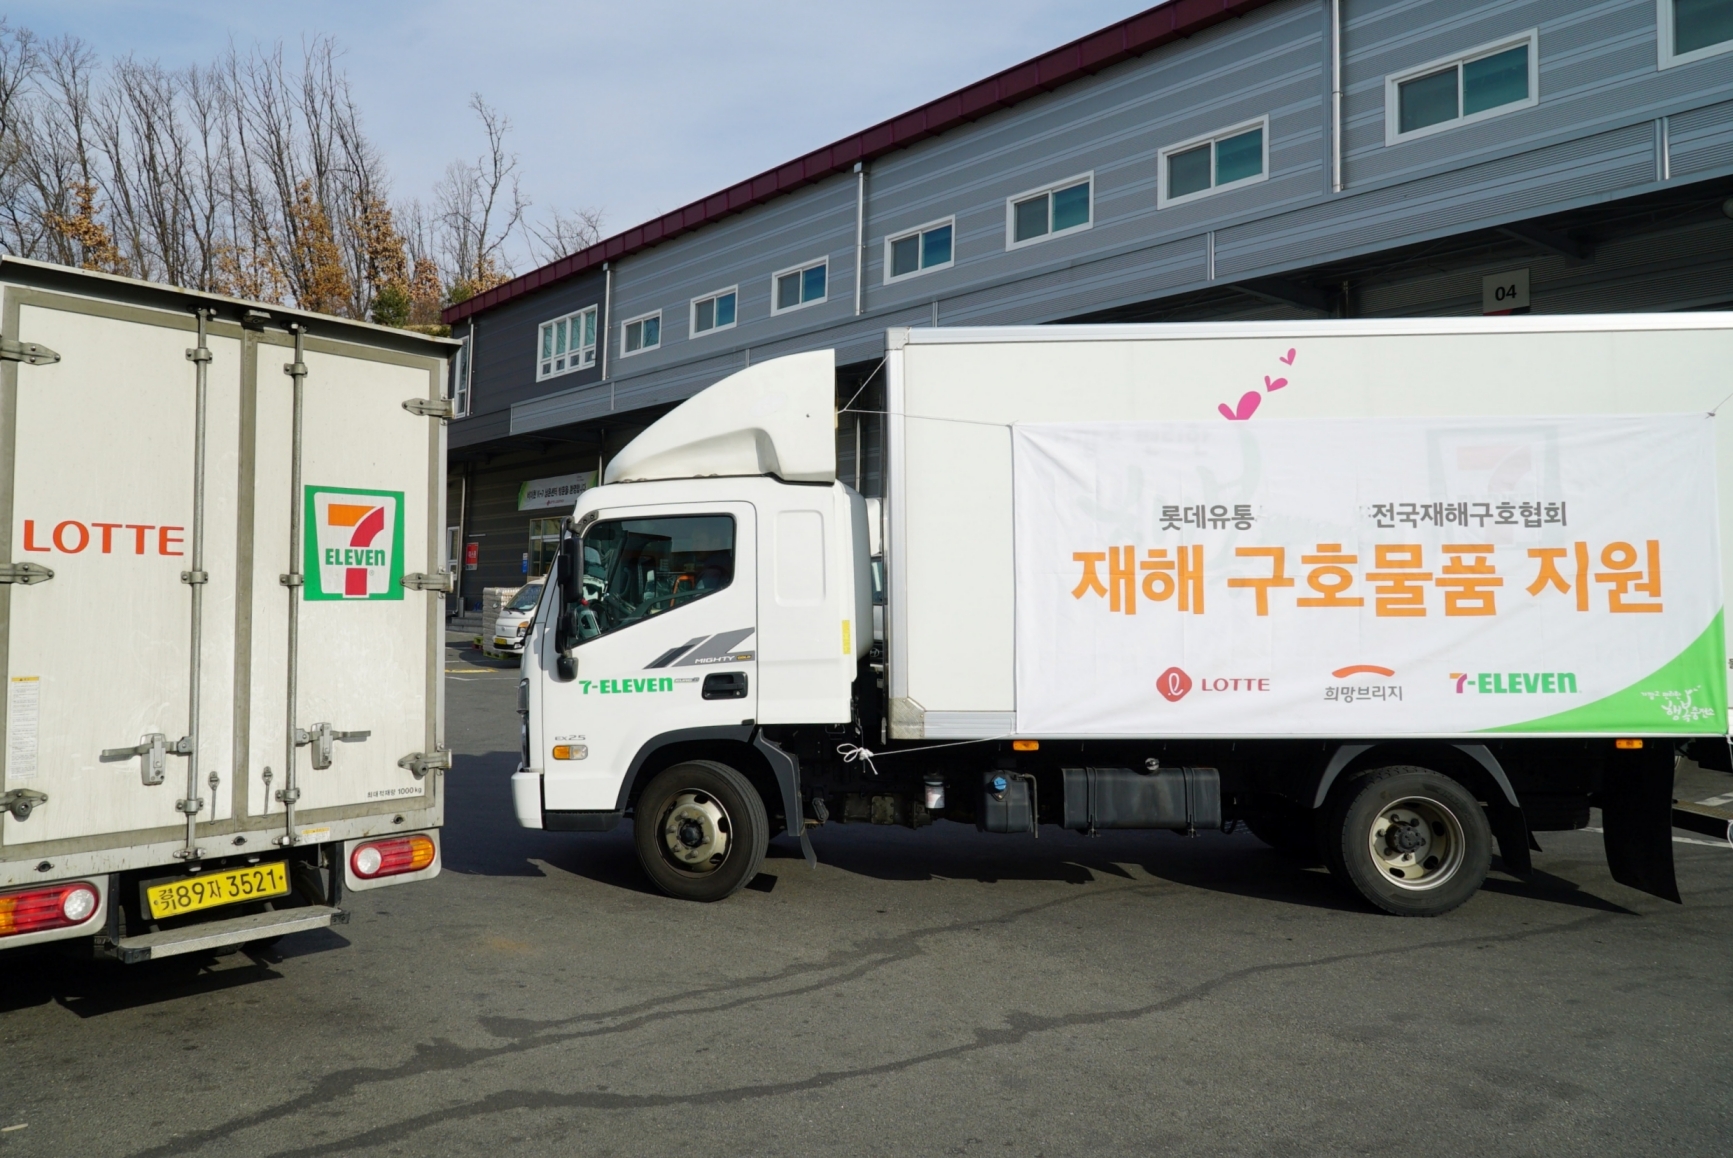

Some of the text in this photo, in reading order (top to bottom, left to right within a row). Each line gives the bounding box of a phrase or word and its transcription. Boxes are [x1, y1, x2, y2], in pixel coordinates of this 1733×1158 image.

[1494, 284, 1518, 302] 04
[1158, 500, 1568, 531] 롯데유통 전국재해구호협회
[23, 519, 185, 556] LOTTE
[1071, 540, 1664, 617] 재해 구호물품 지원
[695, 655, 735, 664] MIGHTY
[1201, 678, 1270, 692] LOTTE
[1323, 685, 1403, 704] 희망브리지
[367, 789, 396, 798] 최대적재량
[226, 868, 277, 897] 3521
